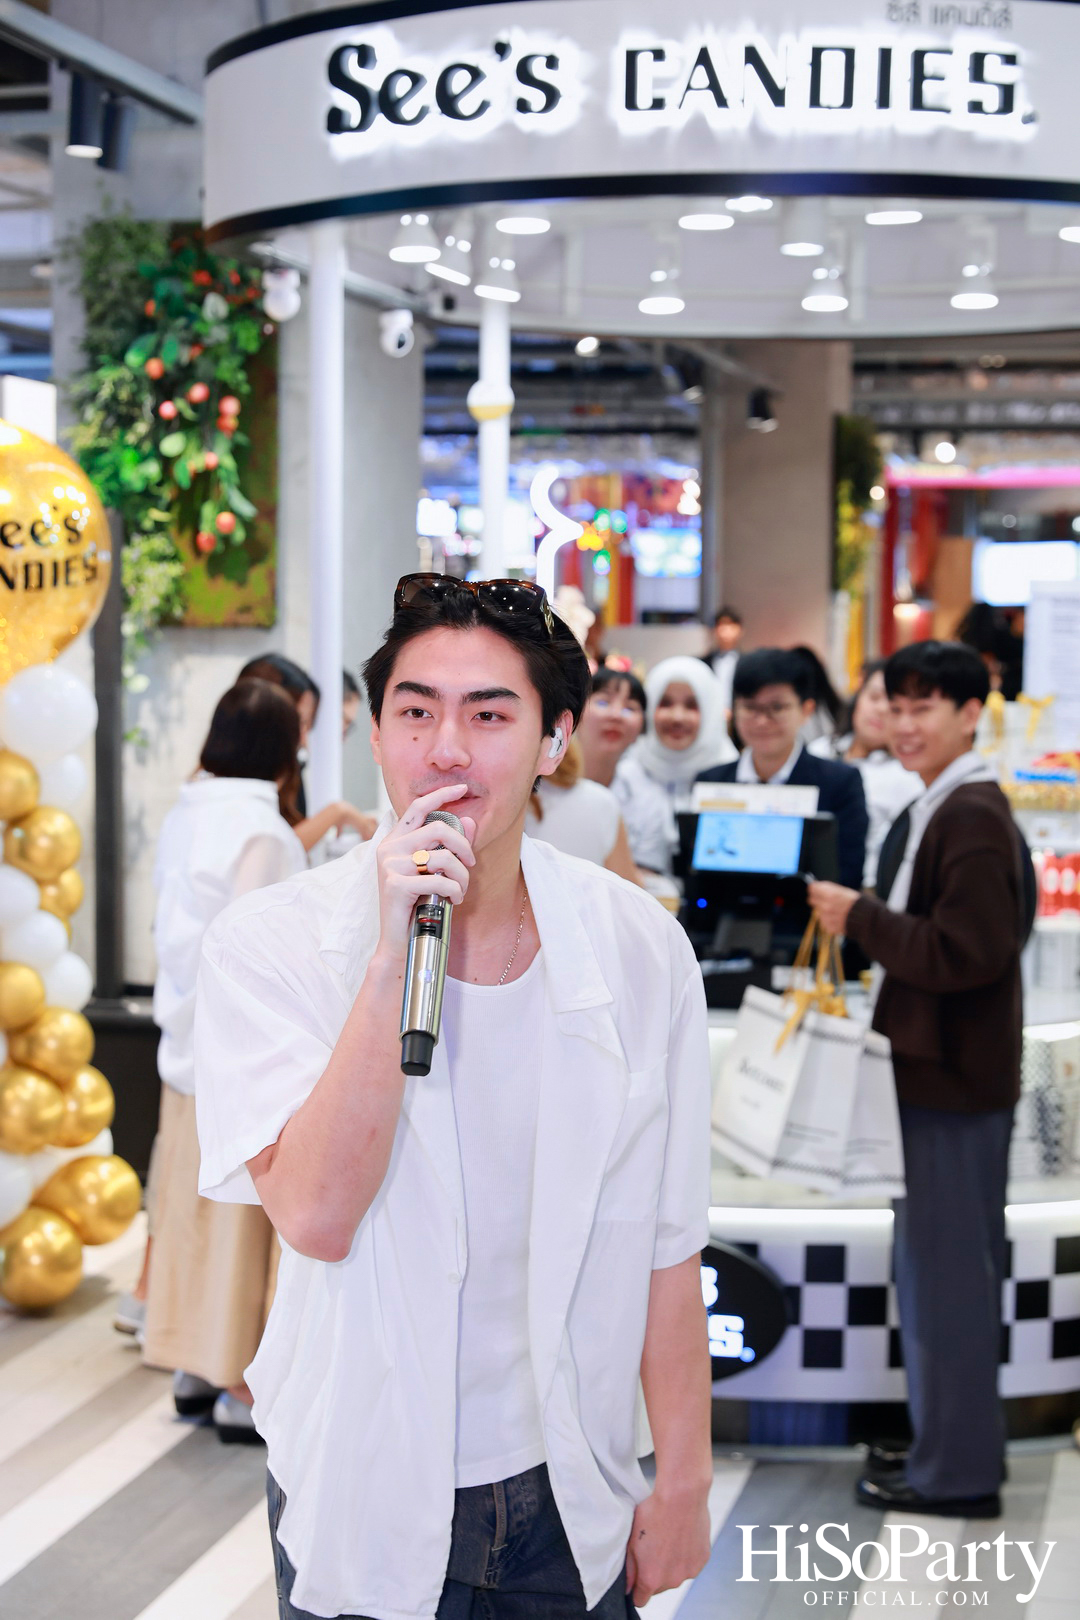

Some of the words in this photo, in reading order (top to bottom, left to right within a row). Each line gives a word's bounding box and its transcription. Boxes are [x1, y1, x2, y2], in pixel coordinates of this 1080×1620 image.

[327, 42, 561, 135] See's
[0, 505, 82, 549] ee's
[0, 551, 98, 591] NDIES
